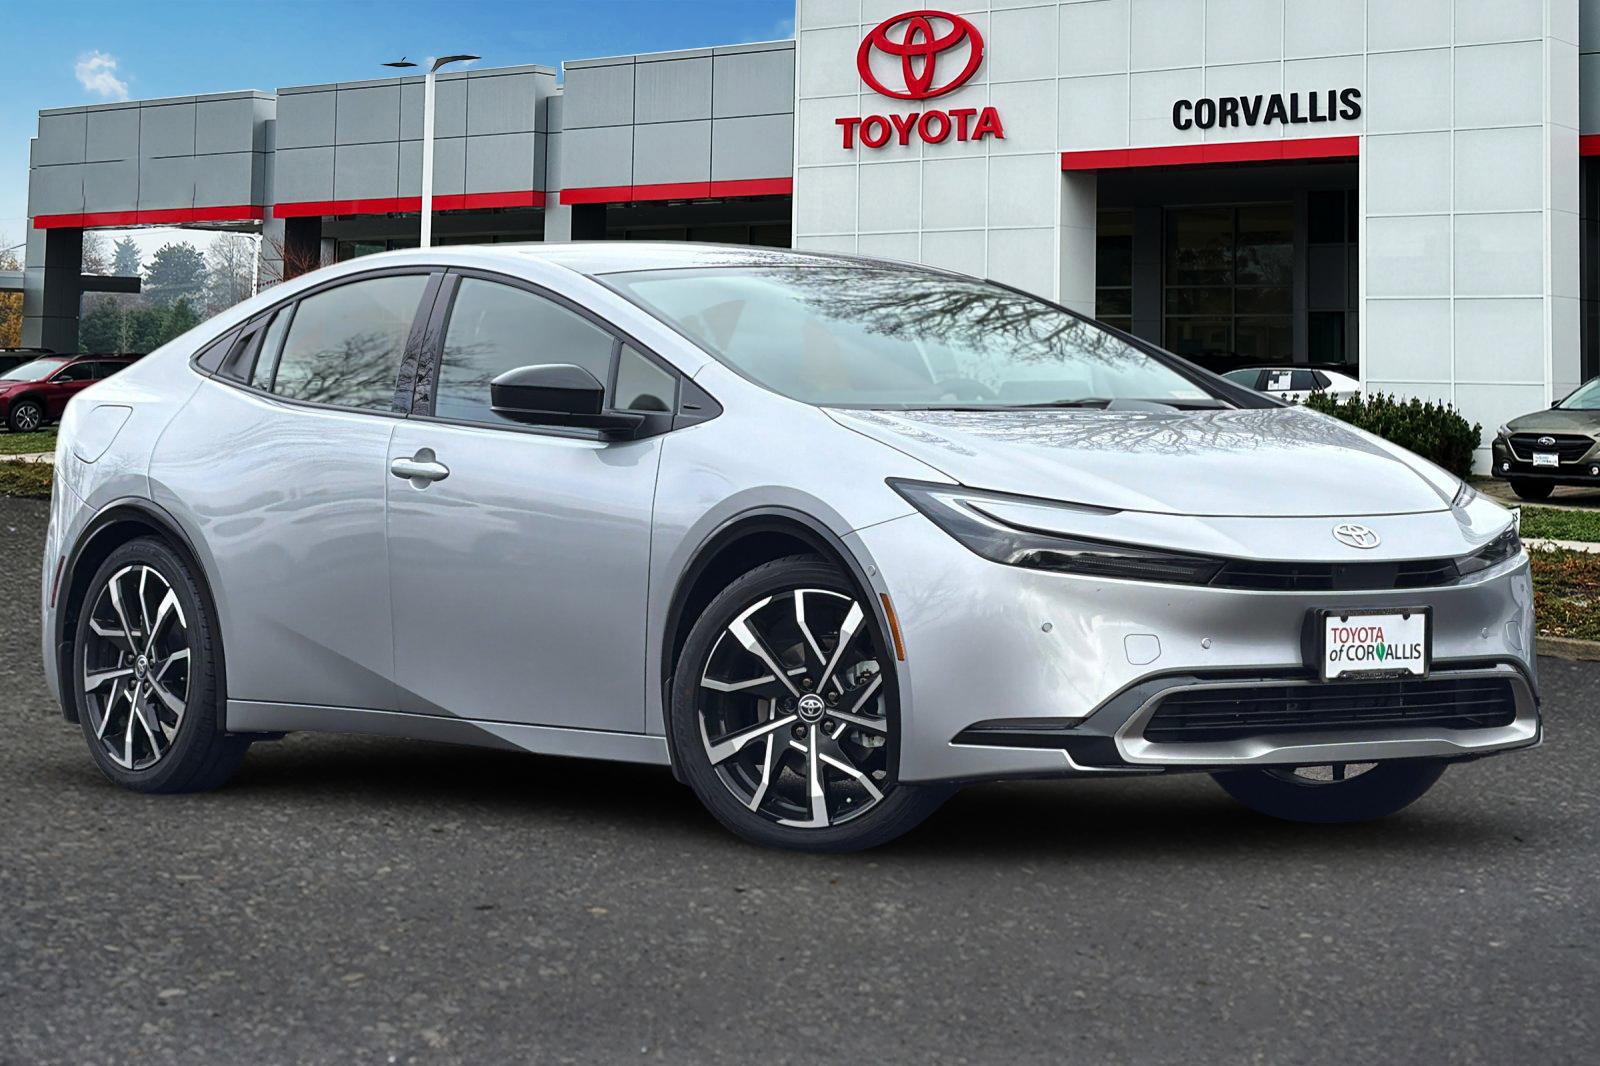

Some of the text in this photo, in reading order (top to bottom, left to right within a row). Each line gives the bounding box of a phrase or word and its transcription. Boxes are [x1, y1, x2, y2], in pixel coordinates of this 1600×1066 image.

[1172, 87, 1362, 131] CORVALLIS
[835, 106, 1005, 149] TOYOTA
[1331, 626, 1385, 644] TOYOTA
[1329, 644, 1345, 662] of
